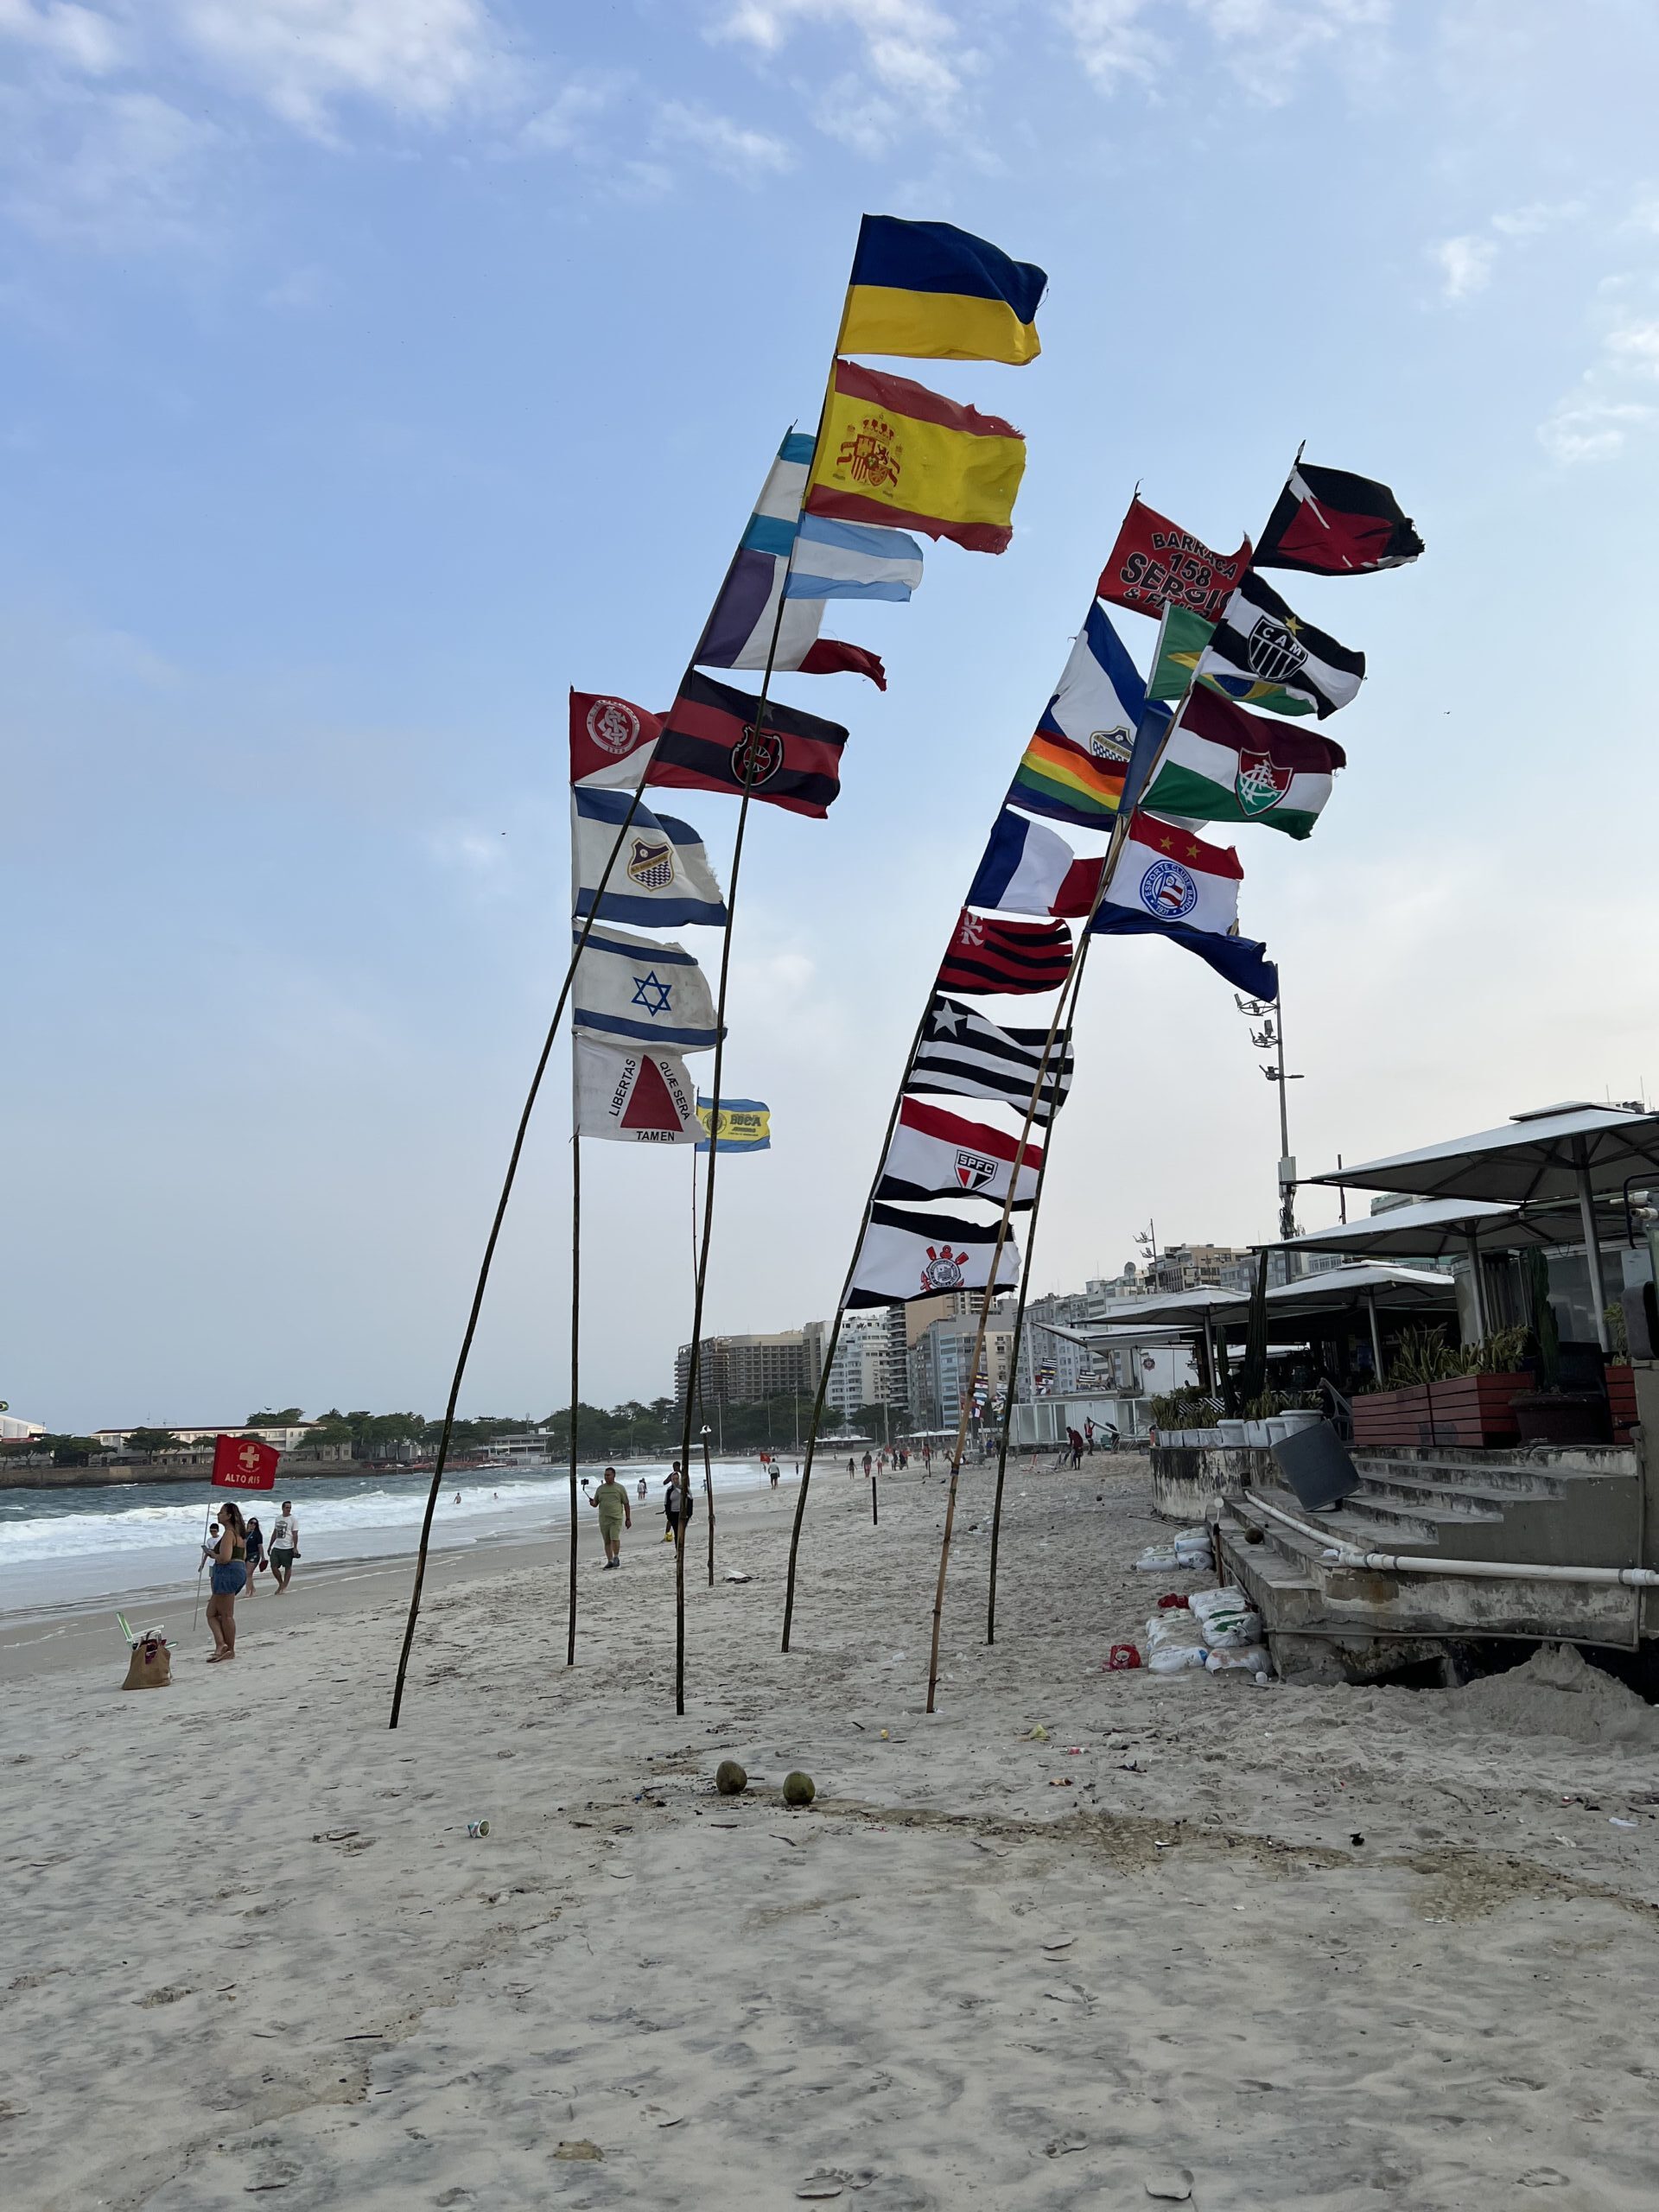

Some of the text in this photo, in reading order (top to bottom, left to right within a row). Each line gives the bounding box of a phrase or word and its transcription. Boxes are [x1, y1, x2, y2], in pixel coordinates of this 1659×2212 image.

[1152, 531, 1237, 580] BARRACA
[1169, 553, 1212, 588] 158
[1145, 864, 1169, 897] ESPORTE
[608, 1058, 636, 1117] LIBERTAS
[636, 1130, 675, 1141] TAMEN
[959, 1155, 994, 1173] SPFC
[225, 1473, 246, 1484] ALTO
